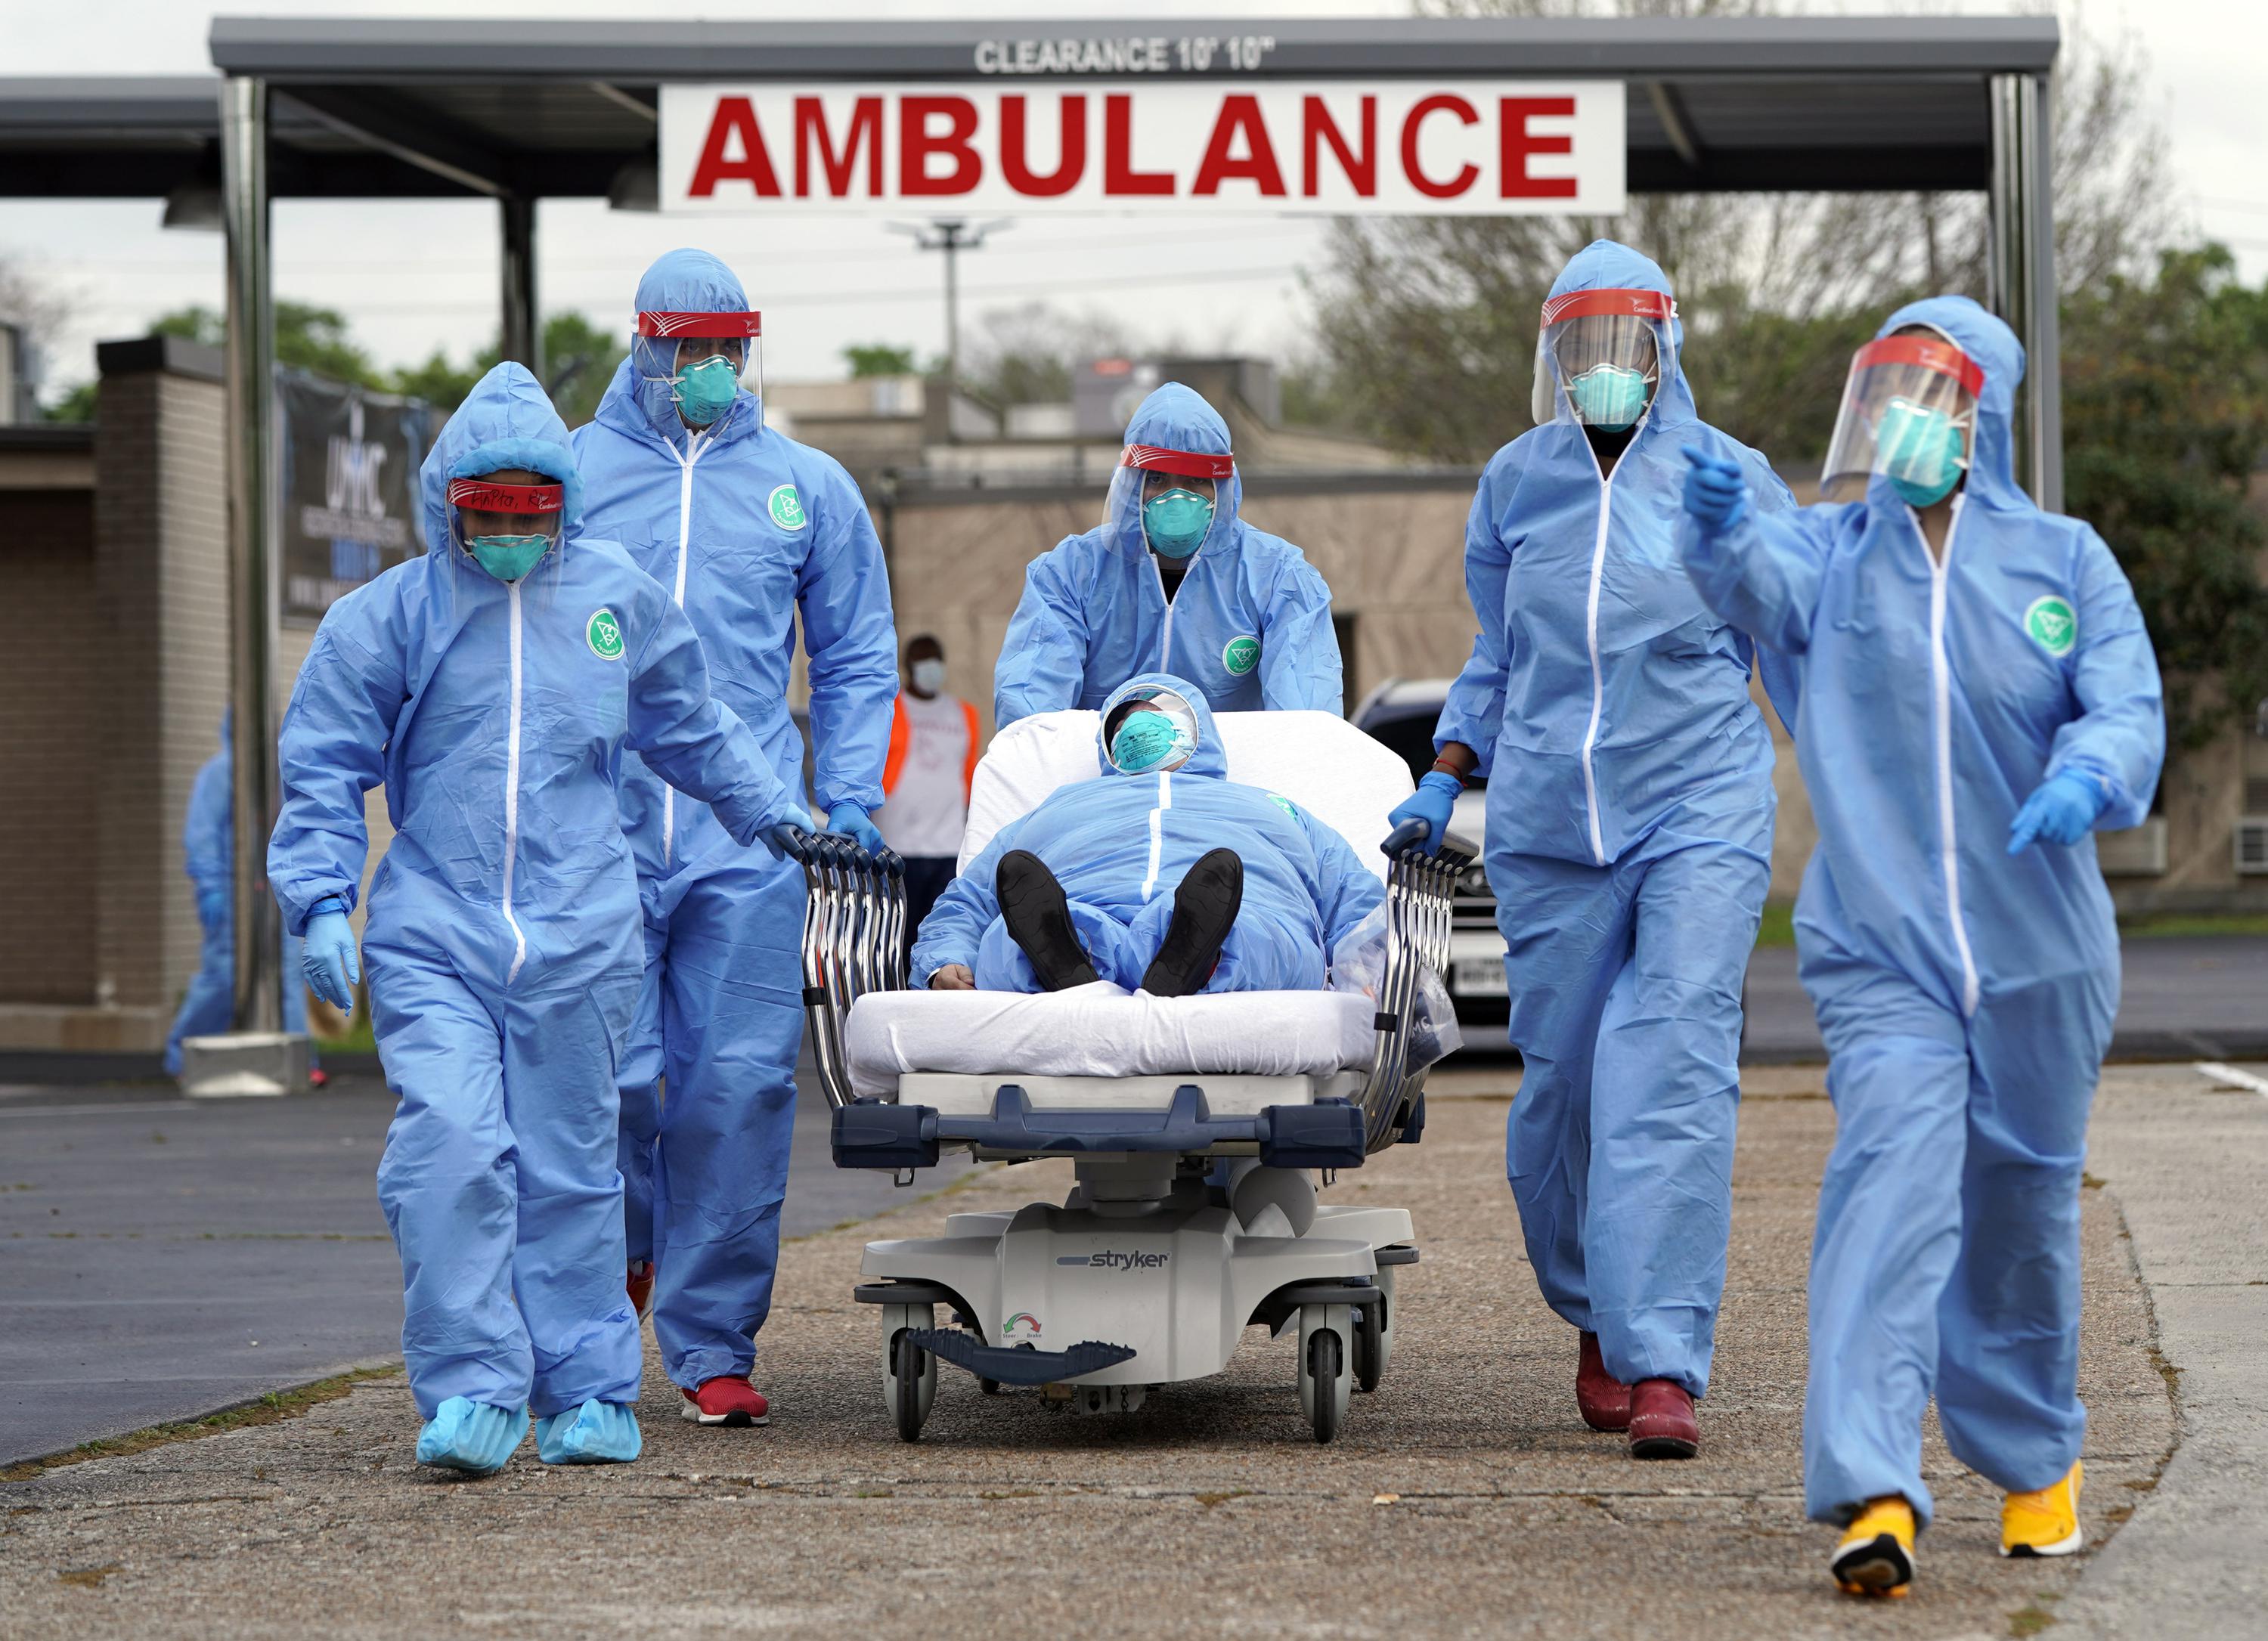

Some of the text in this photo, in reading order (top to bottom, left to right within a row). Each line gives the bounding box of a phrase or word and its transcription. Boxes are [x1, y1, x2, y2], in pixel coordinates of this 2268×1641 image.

[974, 38, 1170, 73] CLEARANCE
[686, 91, 1578, 200] AMBULANCE
[1089, 1249, 1168, 1271] stryker
